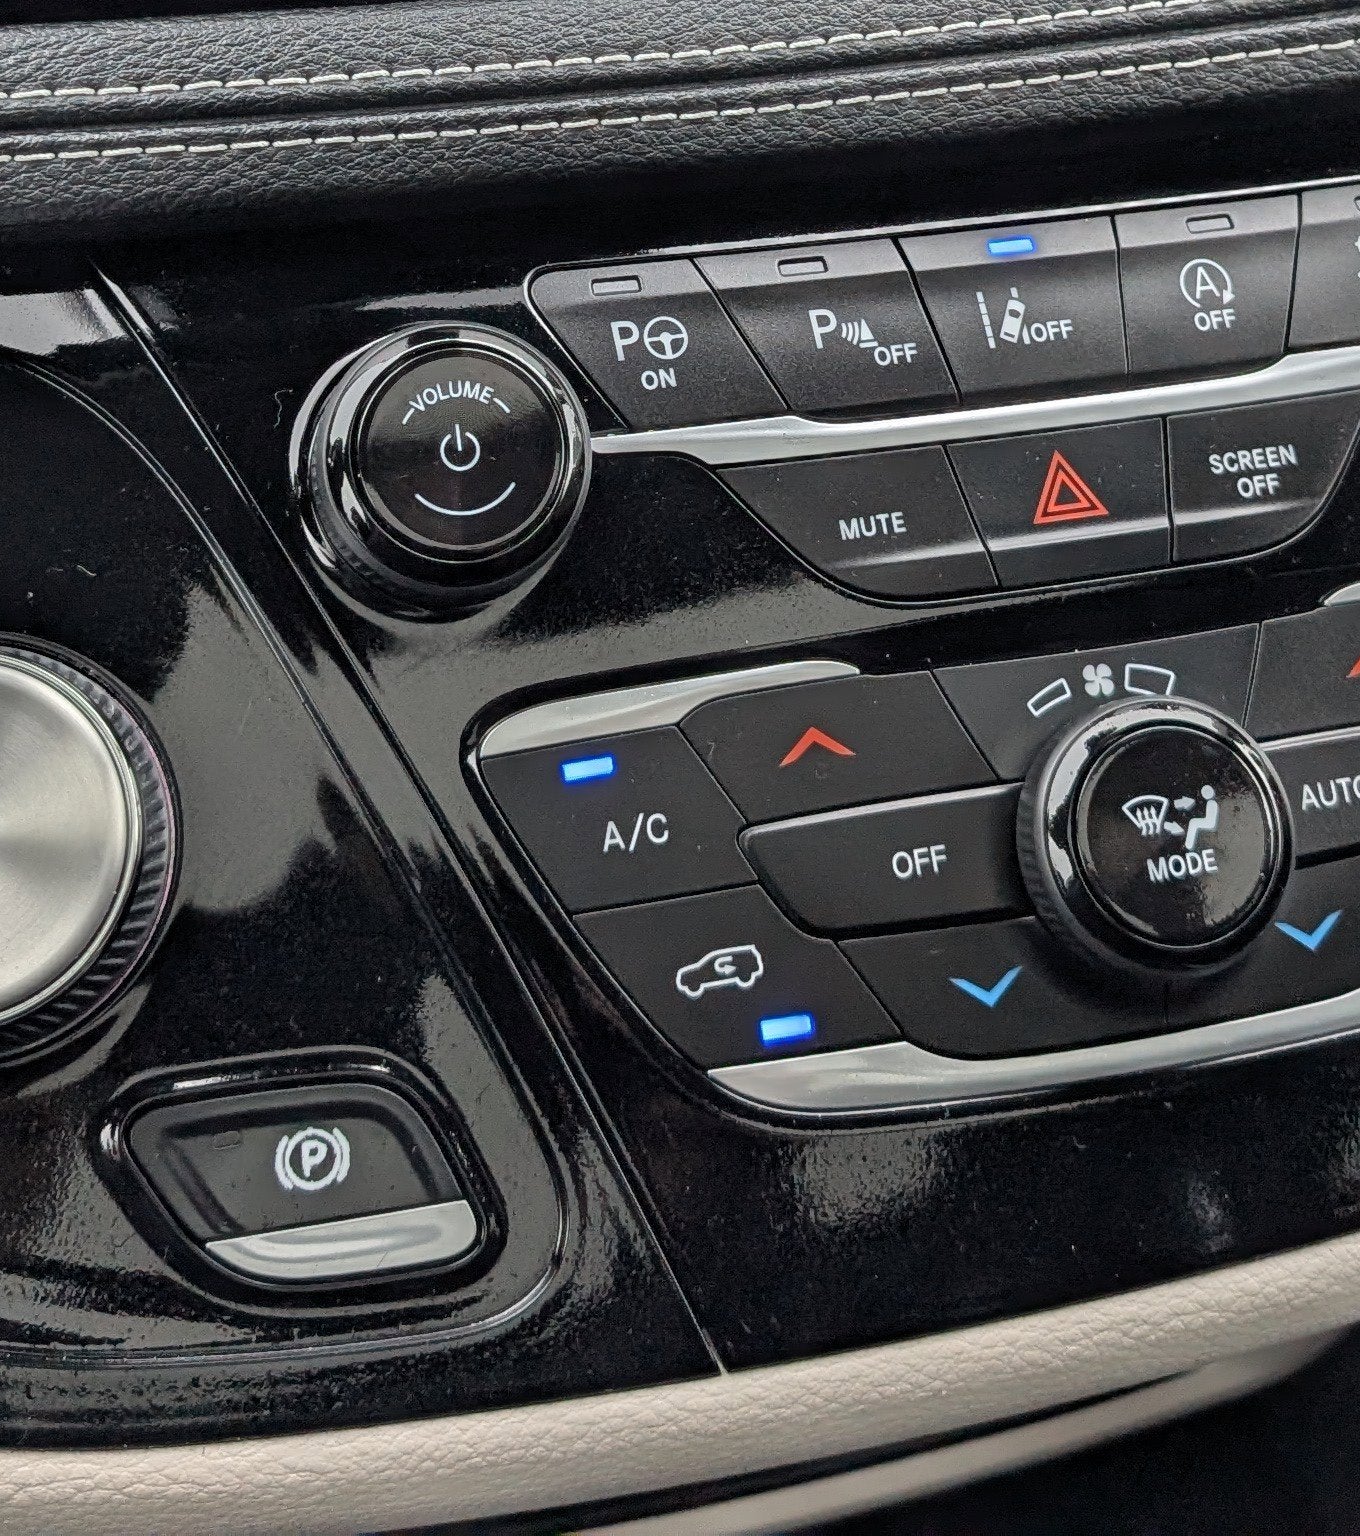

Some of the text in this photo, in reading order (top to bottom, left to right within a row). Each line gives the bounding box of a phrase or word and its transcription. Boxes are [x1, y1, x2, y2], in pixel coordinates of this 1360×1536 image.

[808, 309, 839, 349] P
[1030, 318, 1073, 343] OFF
[1193, 308, 1235, 331] OFF
[610, 320, 640, 361] P
[874, 342, 917, 367] OFF
[641, 368, 677, 391] ON
[410, 381, 494, 414] VOLUME
[1208, 444, 1298, 475] SCREEN
[1236, 474, 1280, 499] OFF
[839, 511, 907, 539] MUTE
[602, 813, 670, 853] A/C
[892, 845, 948, 881] OFF
[1146, 848, 1218, 881] MODE
